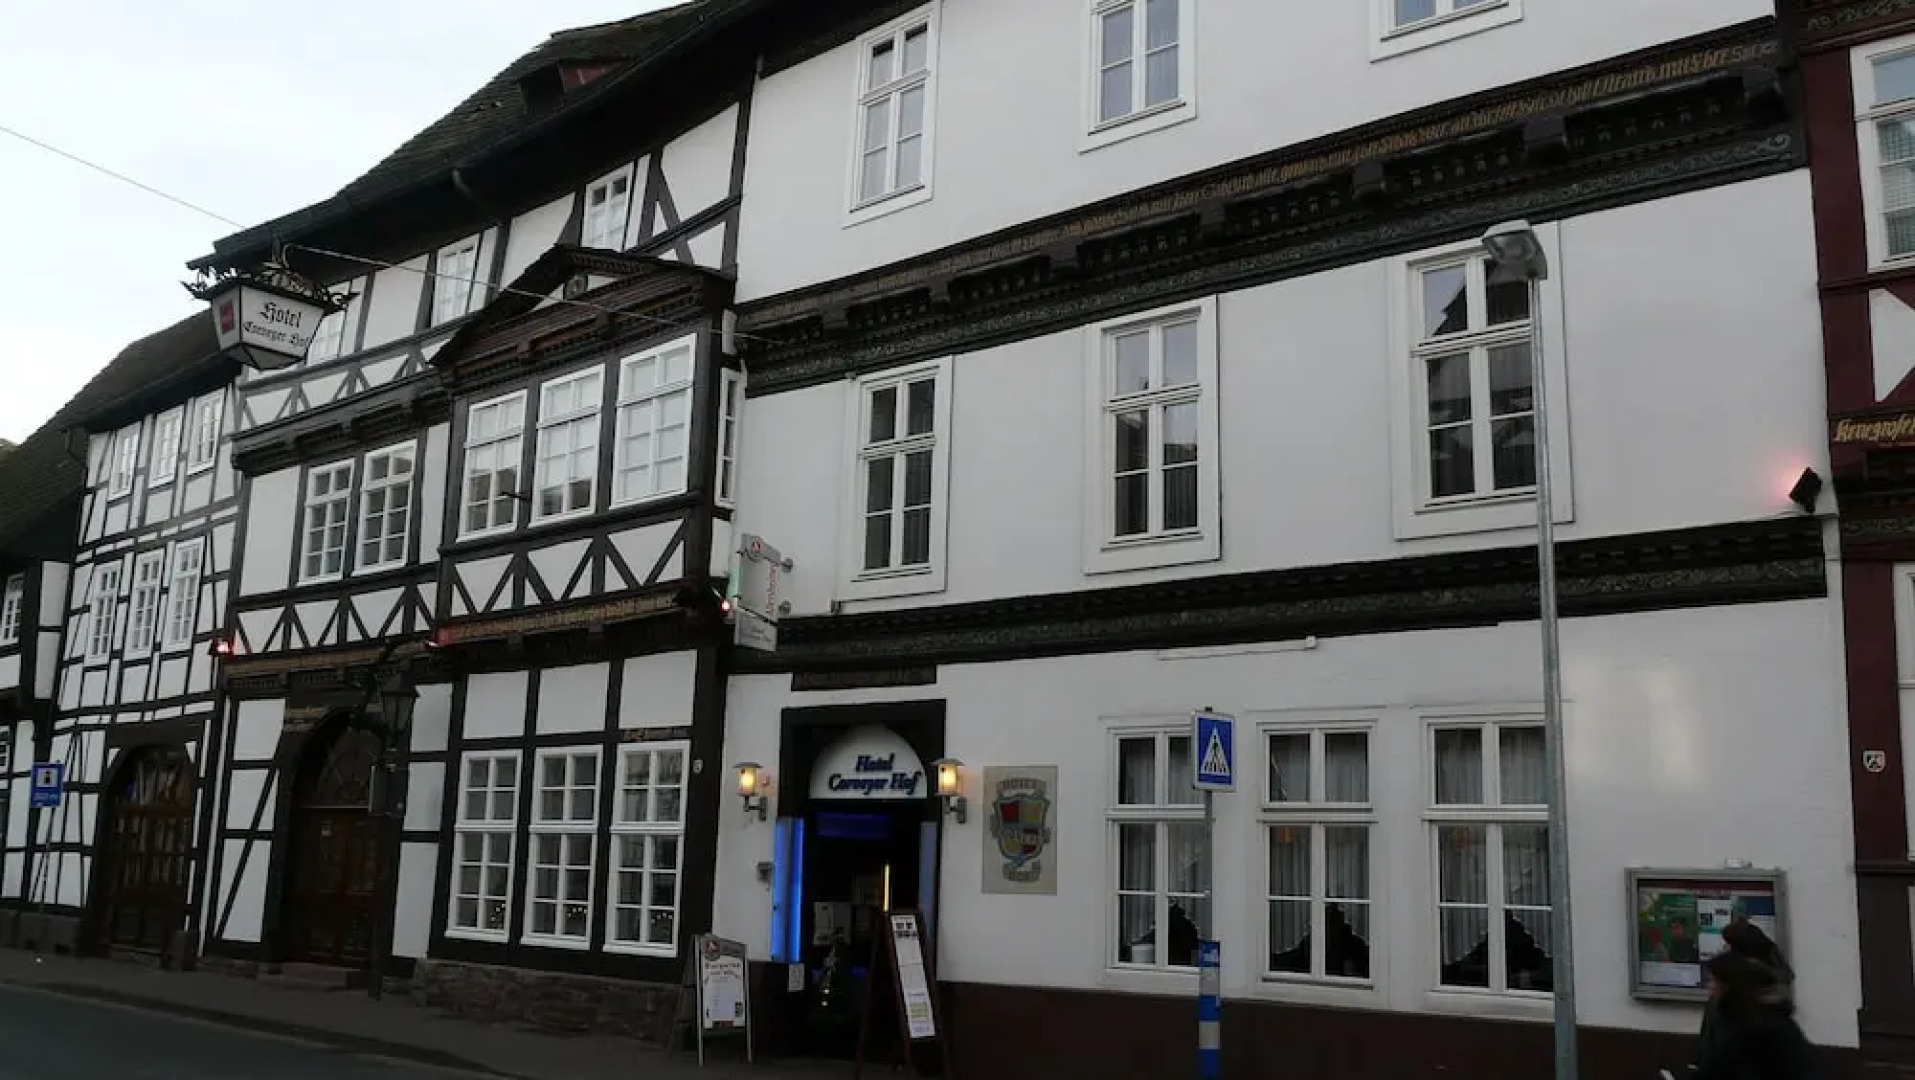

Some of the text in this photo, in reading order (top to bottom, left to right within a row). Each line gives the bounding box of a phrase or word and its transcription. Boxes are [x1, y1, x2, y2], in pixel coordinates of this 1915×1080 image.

[259, 301, 302, 329] Hotel
[855, 752, 895, 772] Hotel
[828, 771, 922, 795] Corveyer Hof
